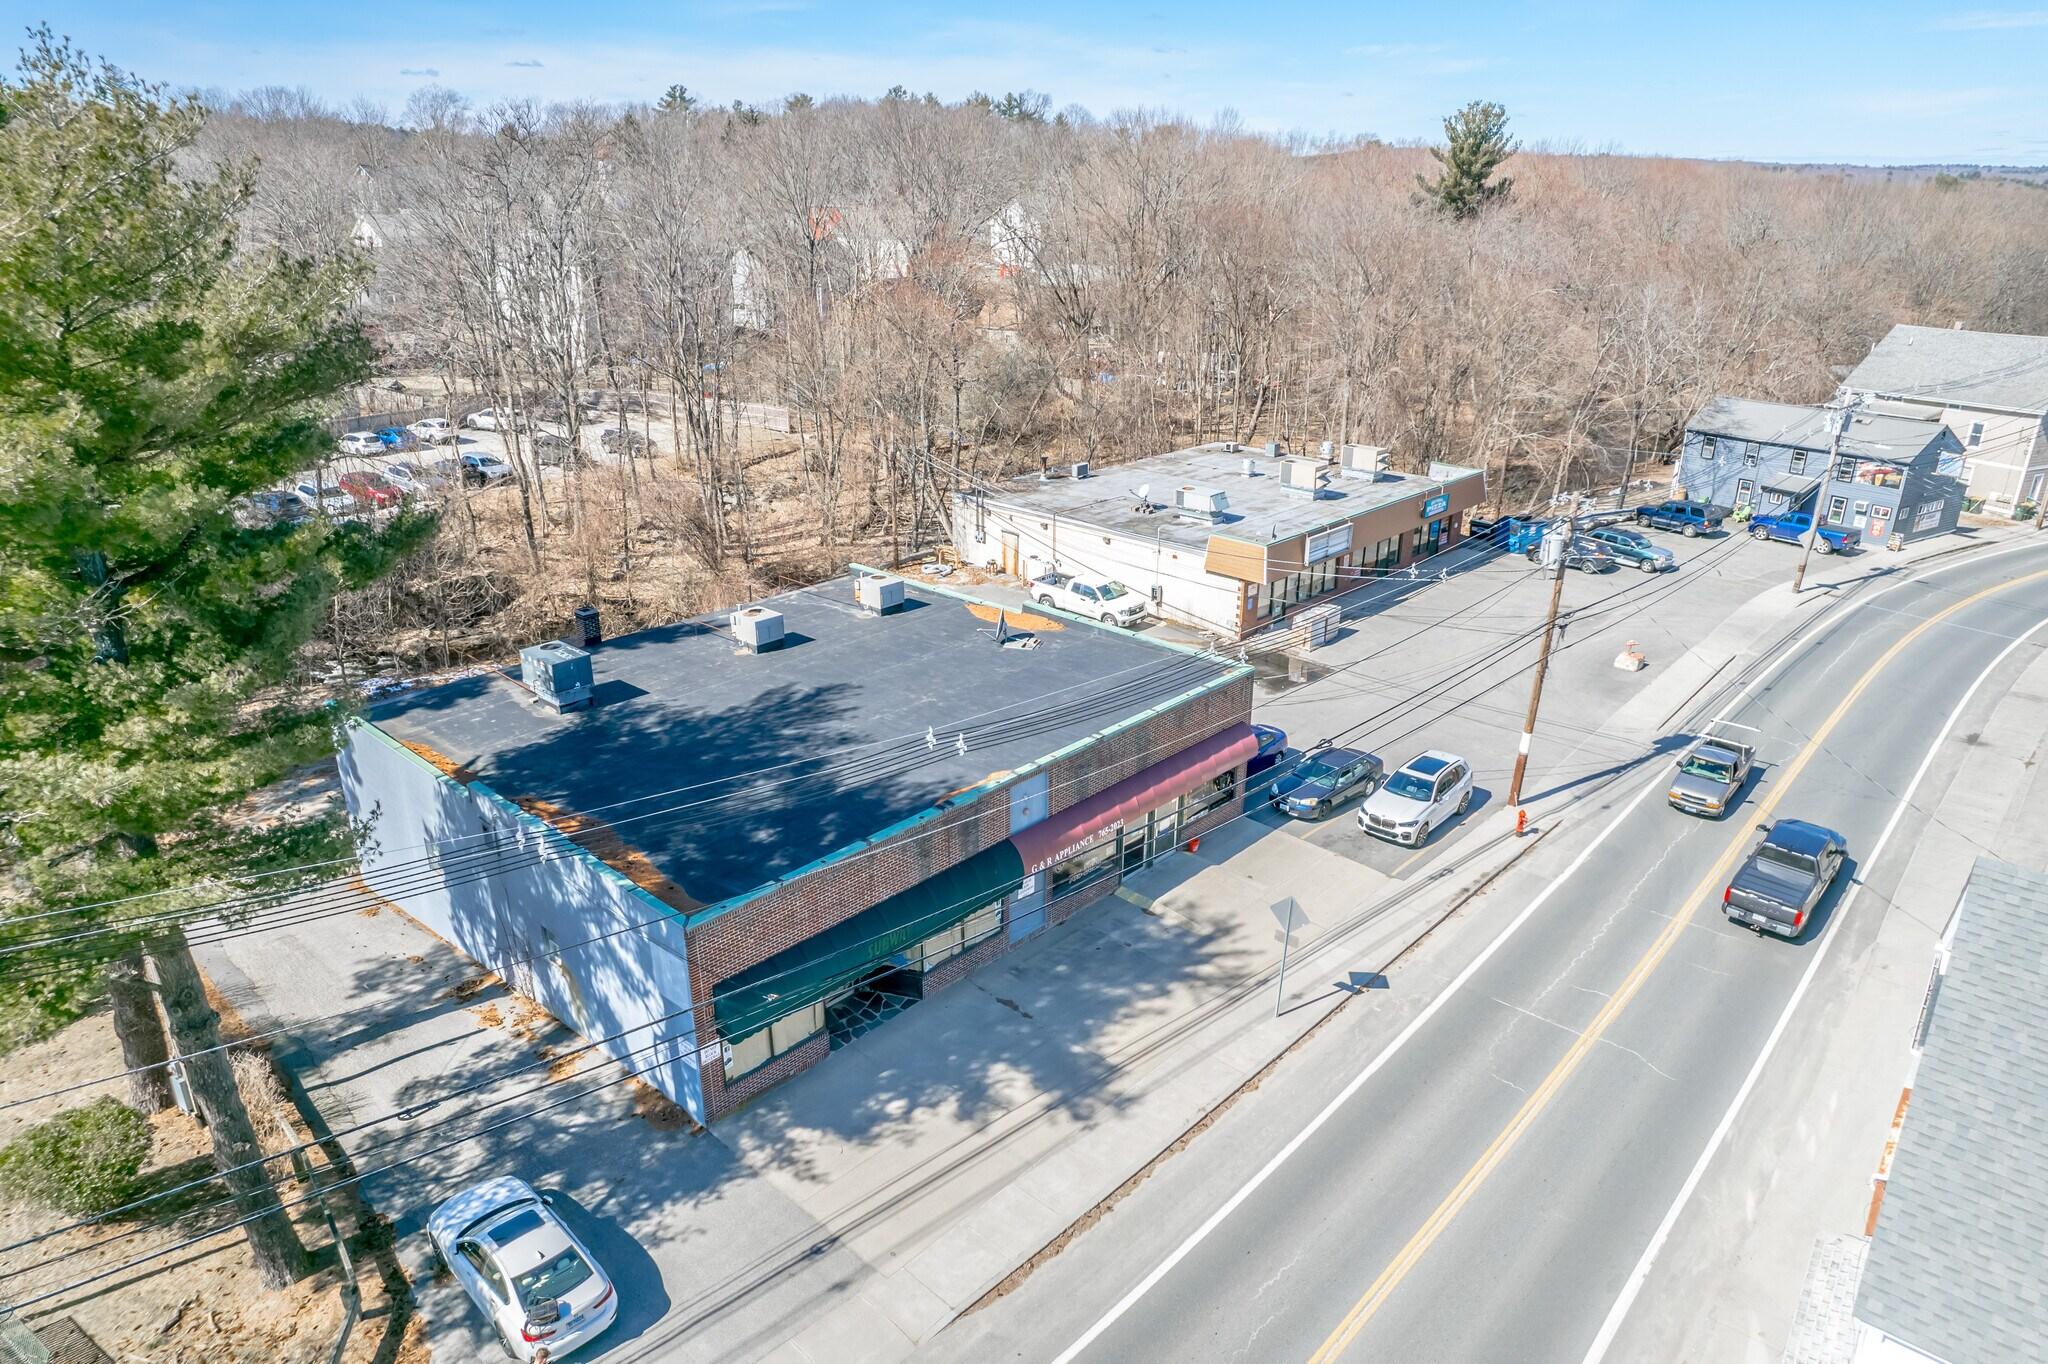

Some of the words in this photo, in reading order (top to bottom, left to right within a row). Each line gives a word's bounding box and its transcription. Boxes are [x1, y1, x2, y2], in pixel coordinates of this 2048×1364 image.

[1031, 864, 1038, 874] G
[1039, 860, 1046, 869] &
[1047, 857, 1053, 867] R
[1054, 833, 1094, 862] APPLIANCE
[1097, 818, 1124, 839] 765-2023
[867, 926, 912, 959] SUBWAY
